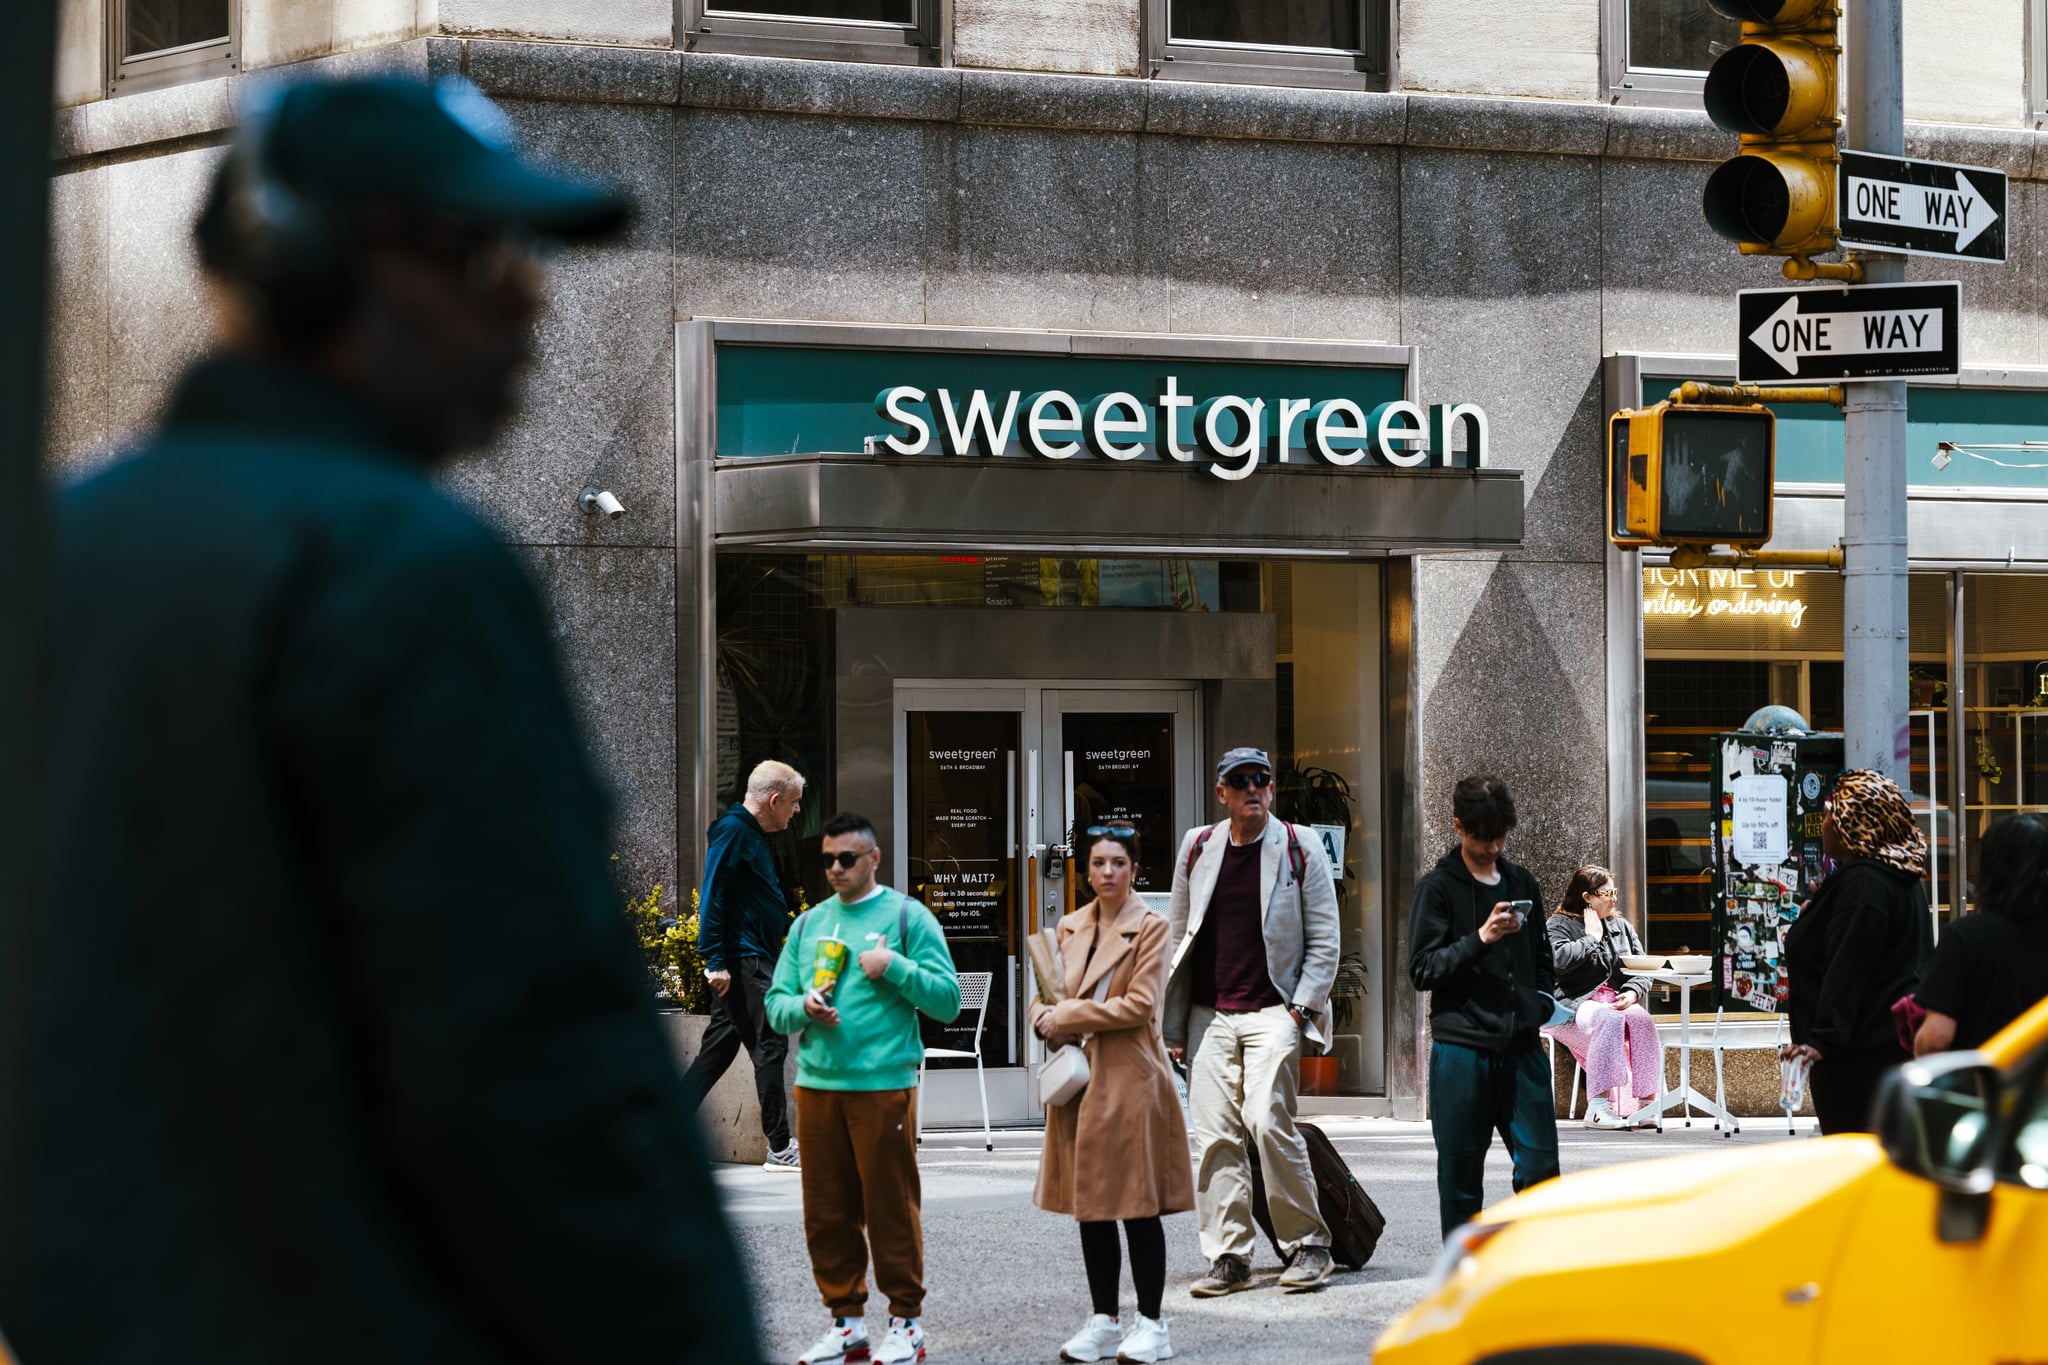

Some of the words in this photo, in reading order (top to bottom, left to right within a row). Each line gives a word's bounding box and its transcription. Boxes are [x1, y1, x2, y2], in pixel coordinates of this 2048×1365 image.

[1857, 183, 1900, 220] ONE
[1925, 191, 1973, 228] WAY
[1772, 318, 1831, 352] ONE
[1863, 314, 1928, 349] WAY
[883, 375, 1489, 481] sweetgreen
[1710, 568, 1757, 589] ME
[1643, 588, 1704, 614] nline
[1706, 590, 1808, 629] ordering
[1085, 749, 1151, 761] sweetgreen
[1321, 831, 1338, 864] A
[933, 873, 958, 884] WHY
[961, 873, 996, 884] WAIT?
[966, 900, 998, 908] sweetgreen
